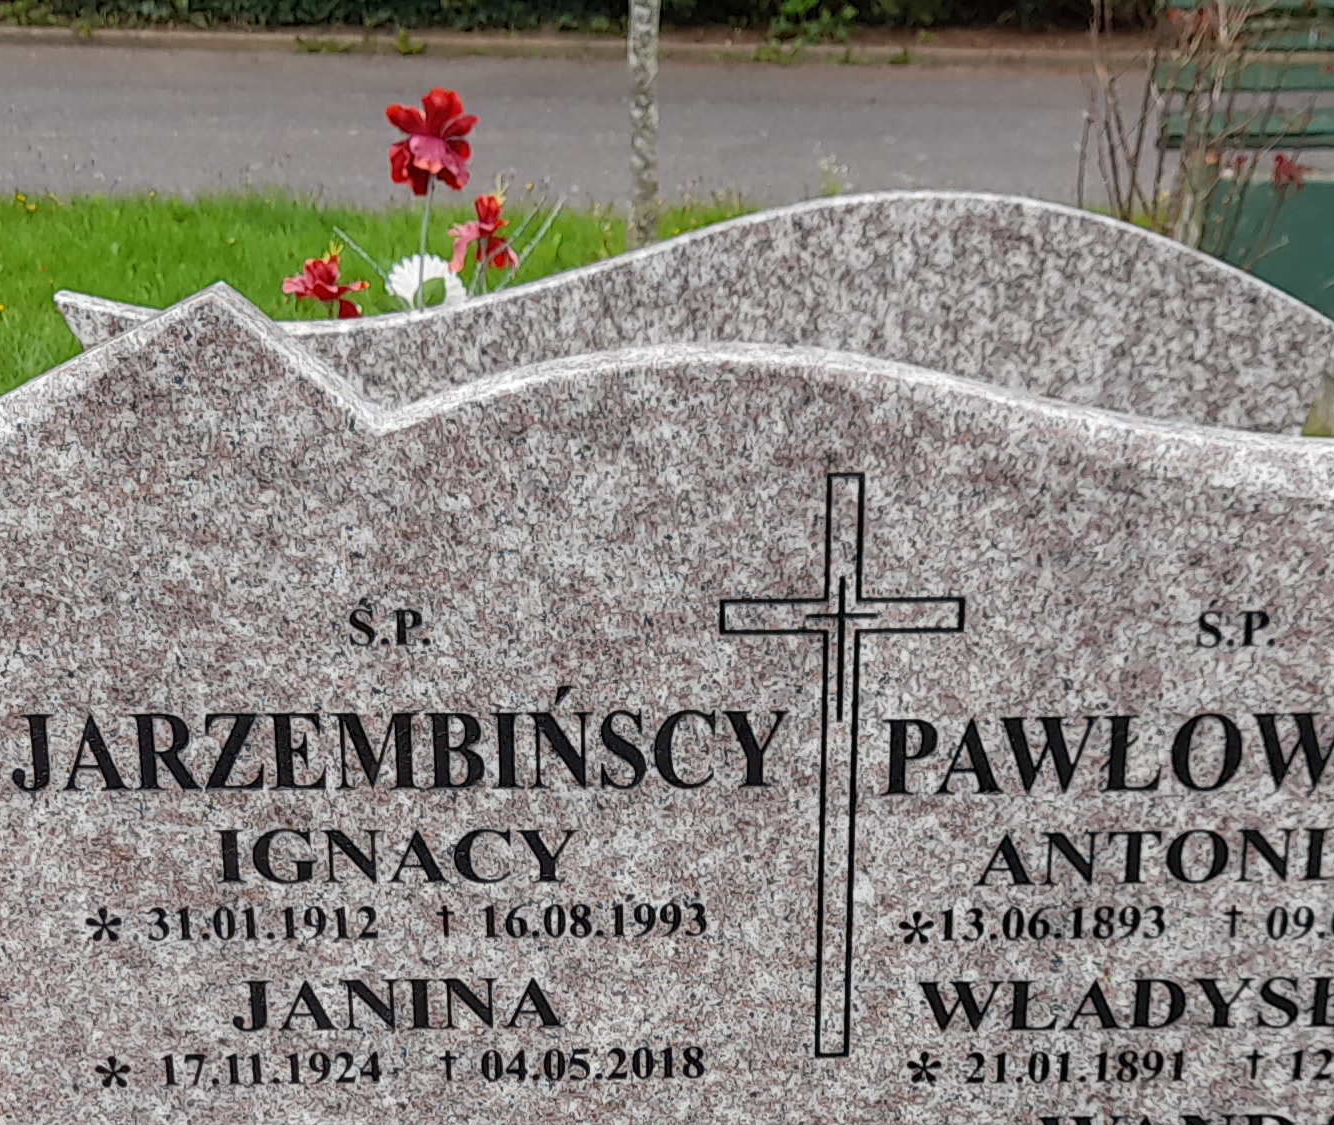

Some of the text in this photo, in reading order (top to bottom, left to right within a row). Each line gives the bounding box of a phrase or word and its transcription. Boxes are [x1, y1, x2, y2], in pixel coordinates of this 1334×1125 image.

[13, 686, 786, 793] JARZEMBIŃSCY
[216, 829, 576, 884] IGNACY
[148, 902, 709, 941] 31.01.1912 16.08.1993
[940, 906, 1166, 942] 13.06.1893
[233, 976, 560, 1032] JANINA
[163, 1046, 705, 1086] 17.11.1924 04.05.2018
[966, 1051, 1184, 1083] 21.01.1891
